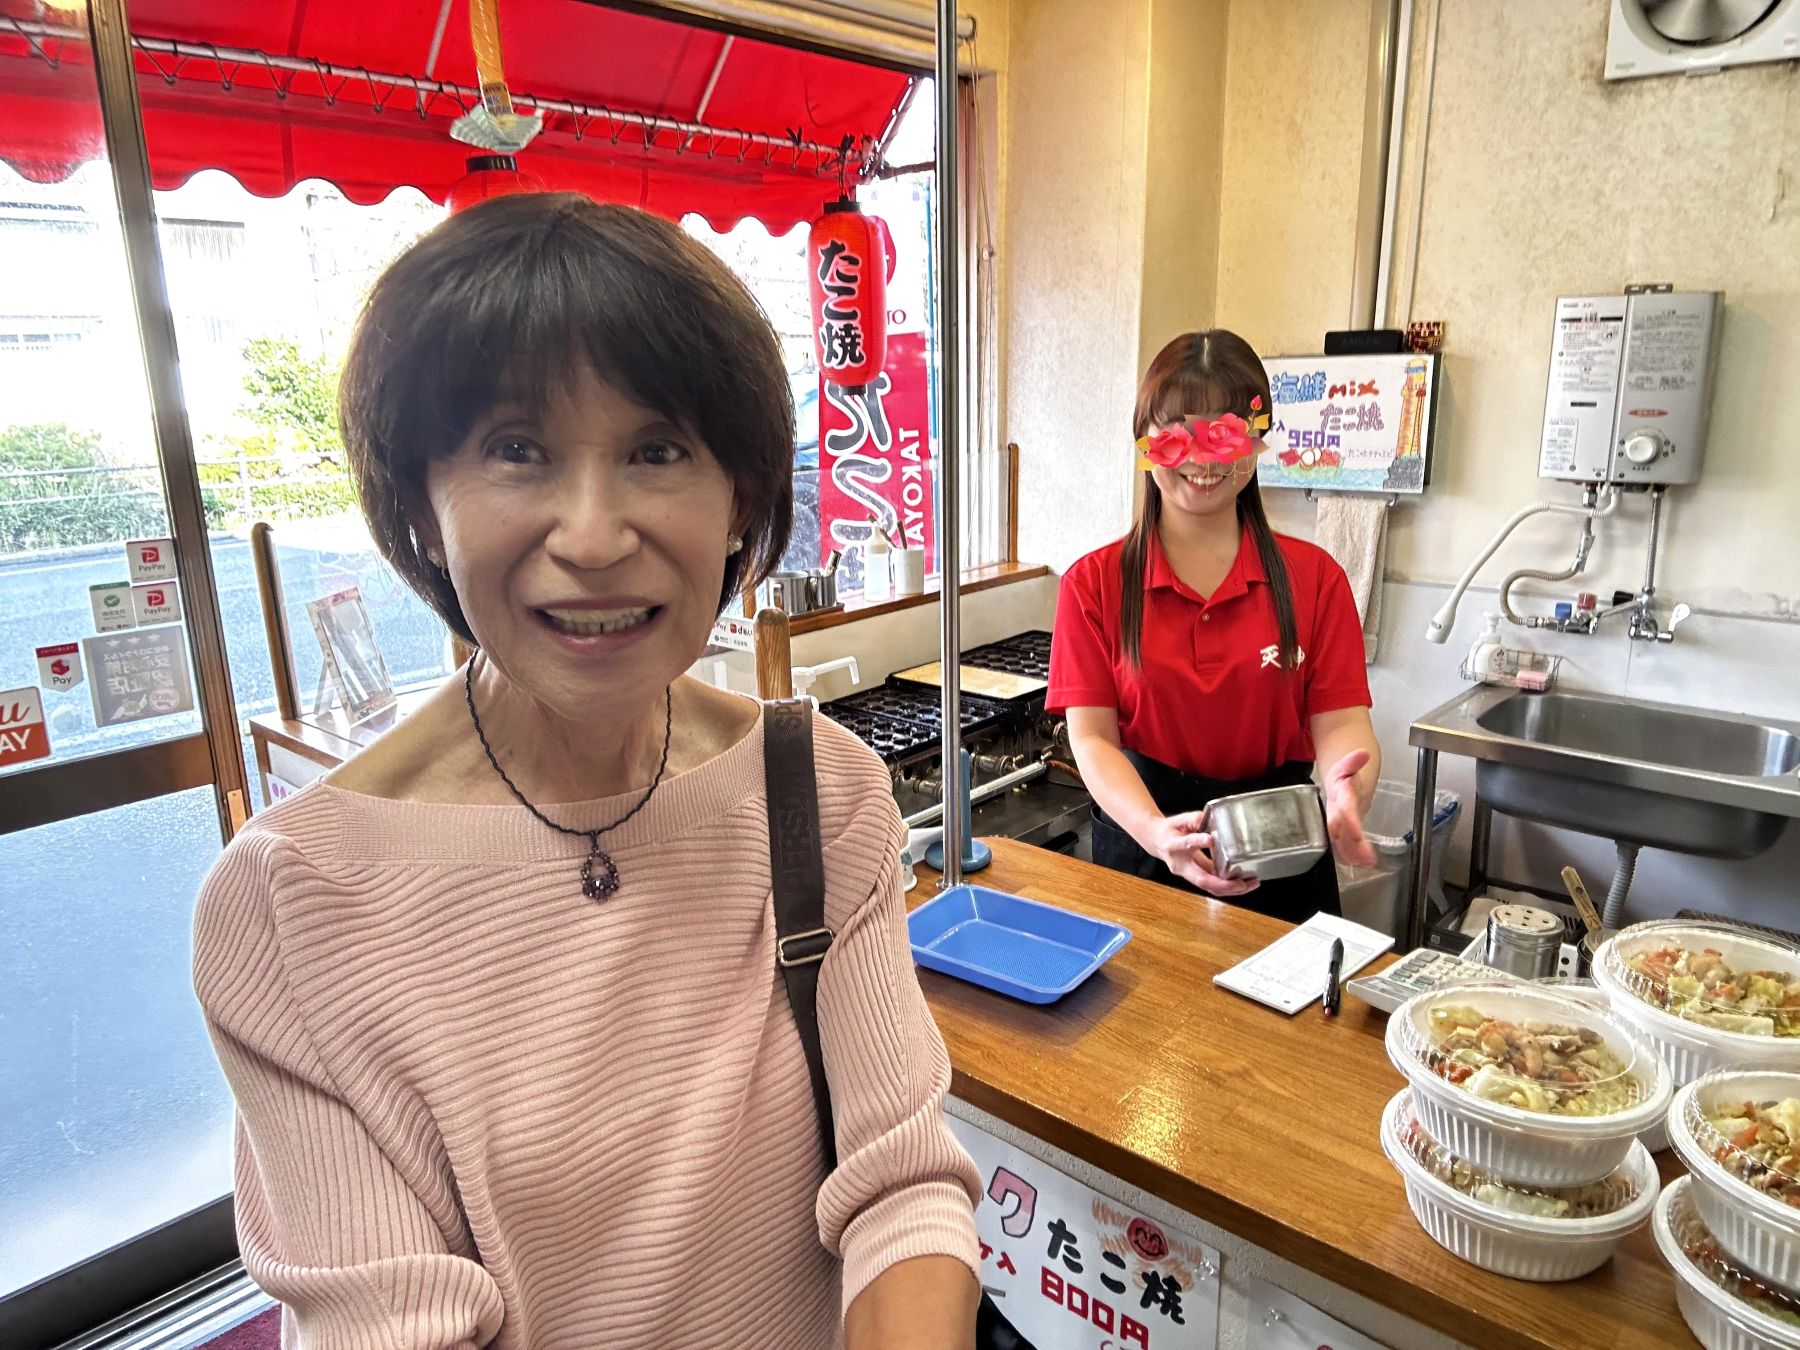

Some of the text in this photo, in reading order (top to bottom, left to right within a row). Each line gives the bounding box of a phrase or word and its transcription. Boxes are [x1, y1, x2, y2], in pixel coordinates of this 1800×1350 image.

[818, 239, 866, 368] たこ焼
[1288, 429, 1341, 448] 950円
[138, 562, 166, 572] PayPay
[143, 605, 171, 615] PayPay
[52, 676, 72, 686] Pay
[1047, 1218, 1186, 1326] たこ焼
[1041, 1265, 1150, 1350] 800円
